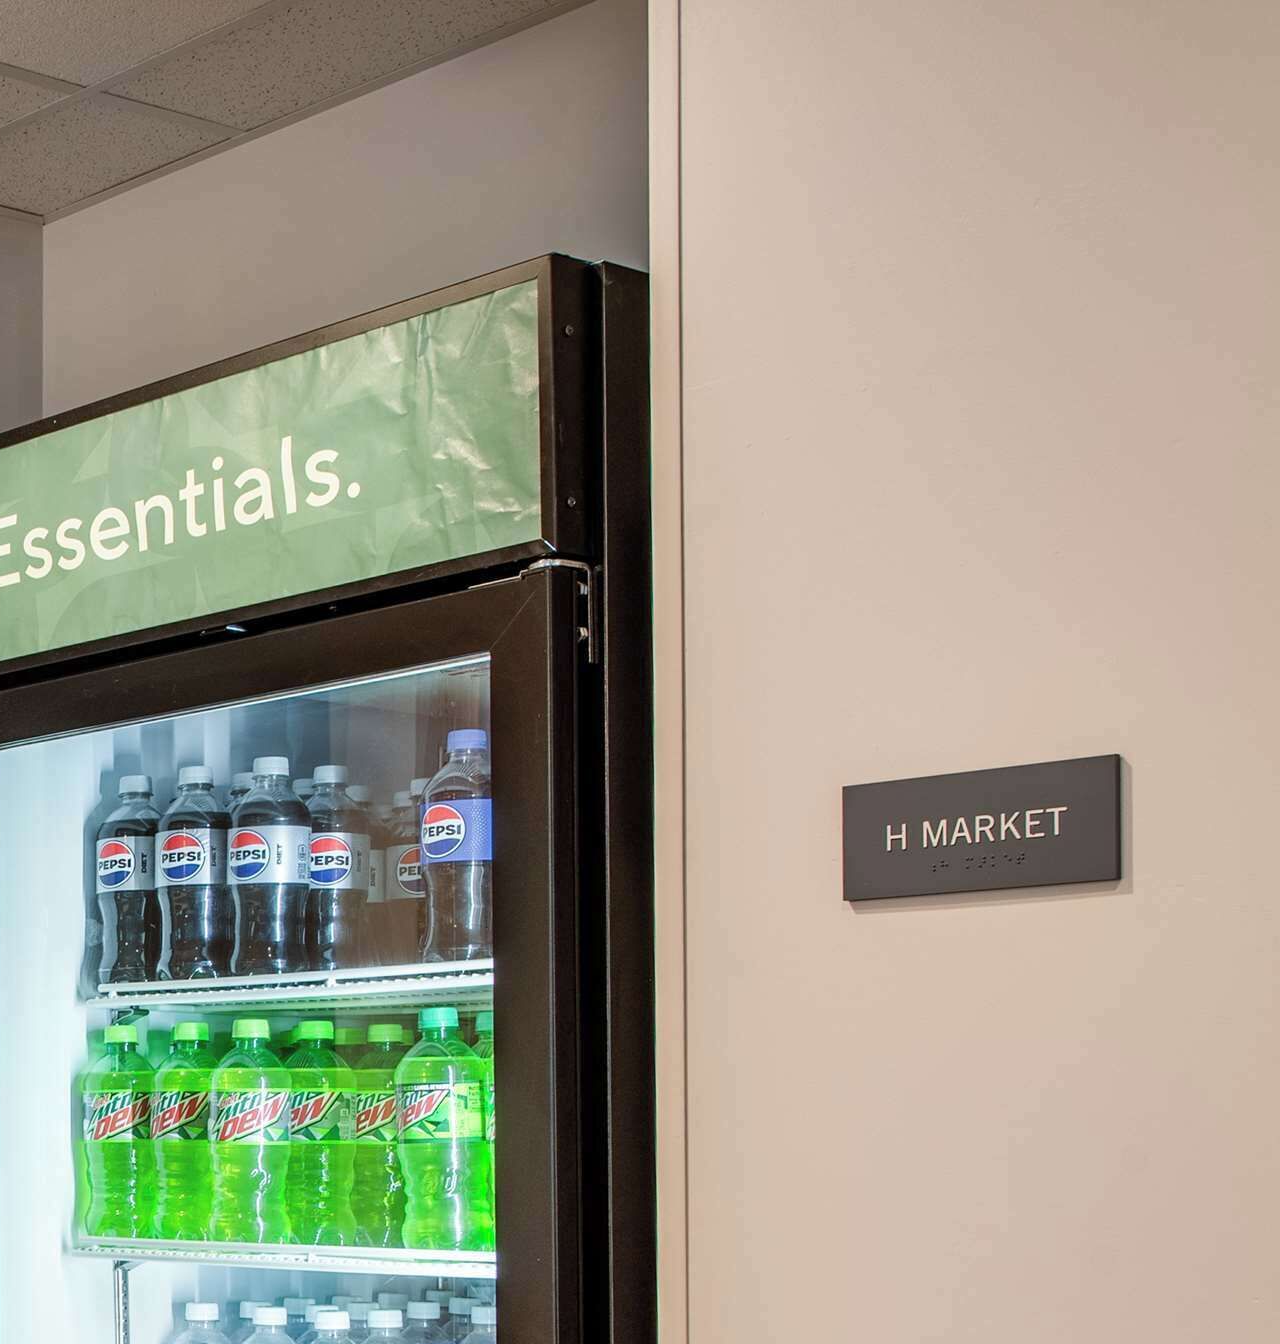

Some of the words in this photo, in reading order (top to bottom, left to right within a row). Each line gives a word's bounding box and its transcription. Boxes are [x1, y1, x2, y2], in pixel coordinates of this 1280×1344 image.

[423, 824, 462, 838] PEPSI
[886, 823, 907, 852] H
[922, 806, 1069, 849] MARKET
[161, 851, 201, 864] PEPSI
[230, 849, 266, 861] PEPSI
[98, 858, 132, 871] PEPSI
